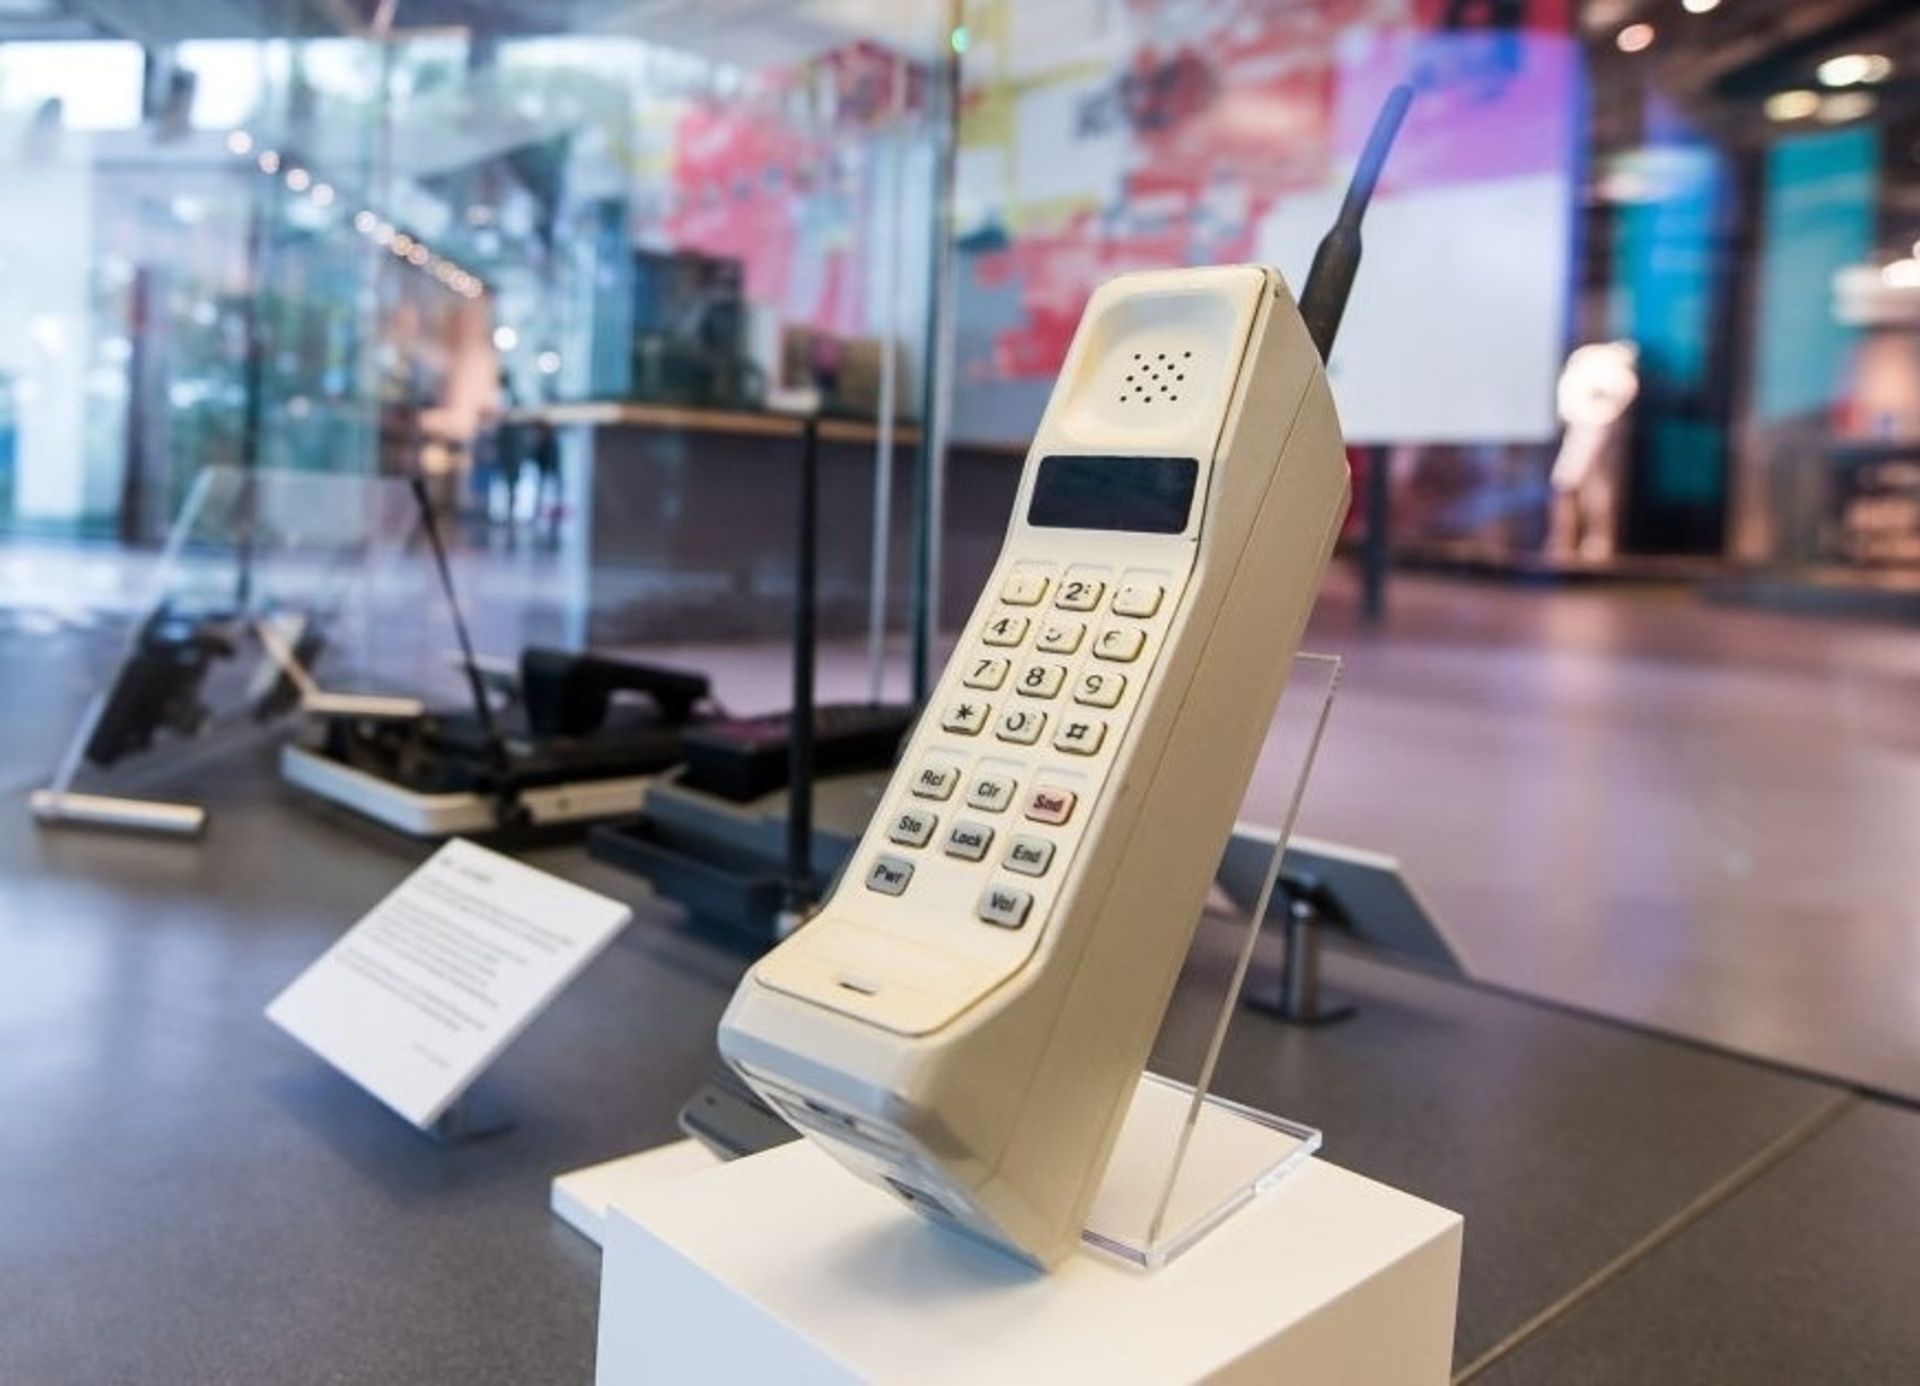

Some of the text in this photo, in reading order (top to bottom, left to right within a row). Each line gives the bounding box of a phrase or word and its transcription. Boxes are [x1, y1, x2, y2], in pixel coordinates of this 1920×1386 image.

[1065, 582, 1083, 601] 2
[973, 659, 993, 678] 7
[1025, 666, 1046, 687] 8
[1086, 674, 1103, 694] 9
[920, 769, 946, 787] Rcl
[977, 781, 1001, 798] Clr
[1033, 793, 1065, 813] Snd
[898, 815, 923, 833] Sto
[950, 828, 983, 848] Lock
[1012, 844, 1043, 863] End
[873, 864, 904, 884] Pwr
[990, 892, 1017, 912] Vol
